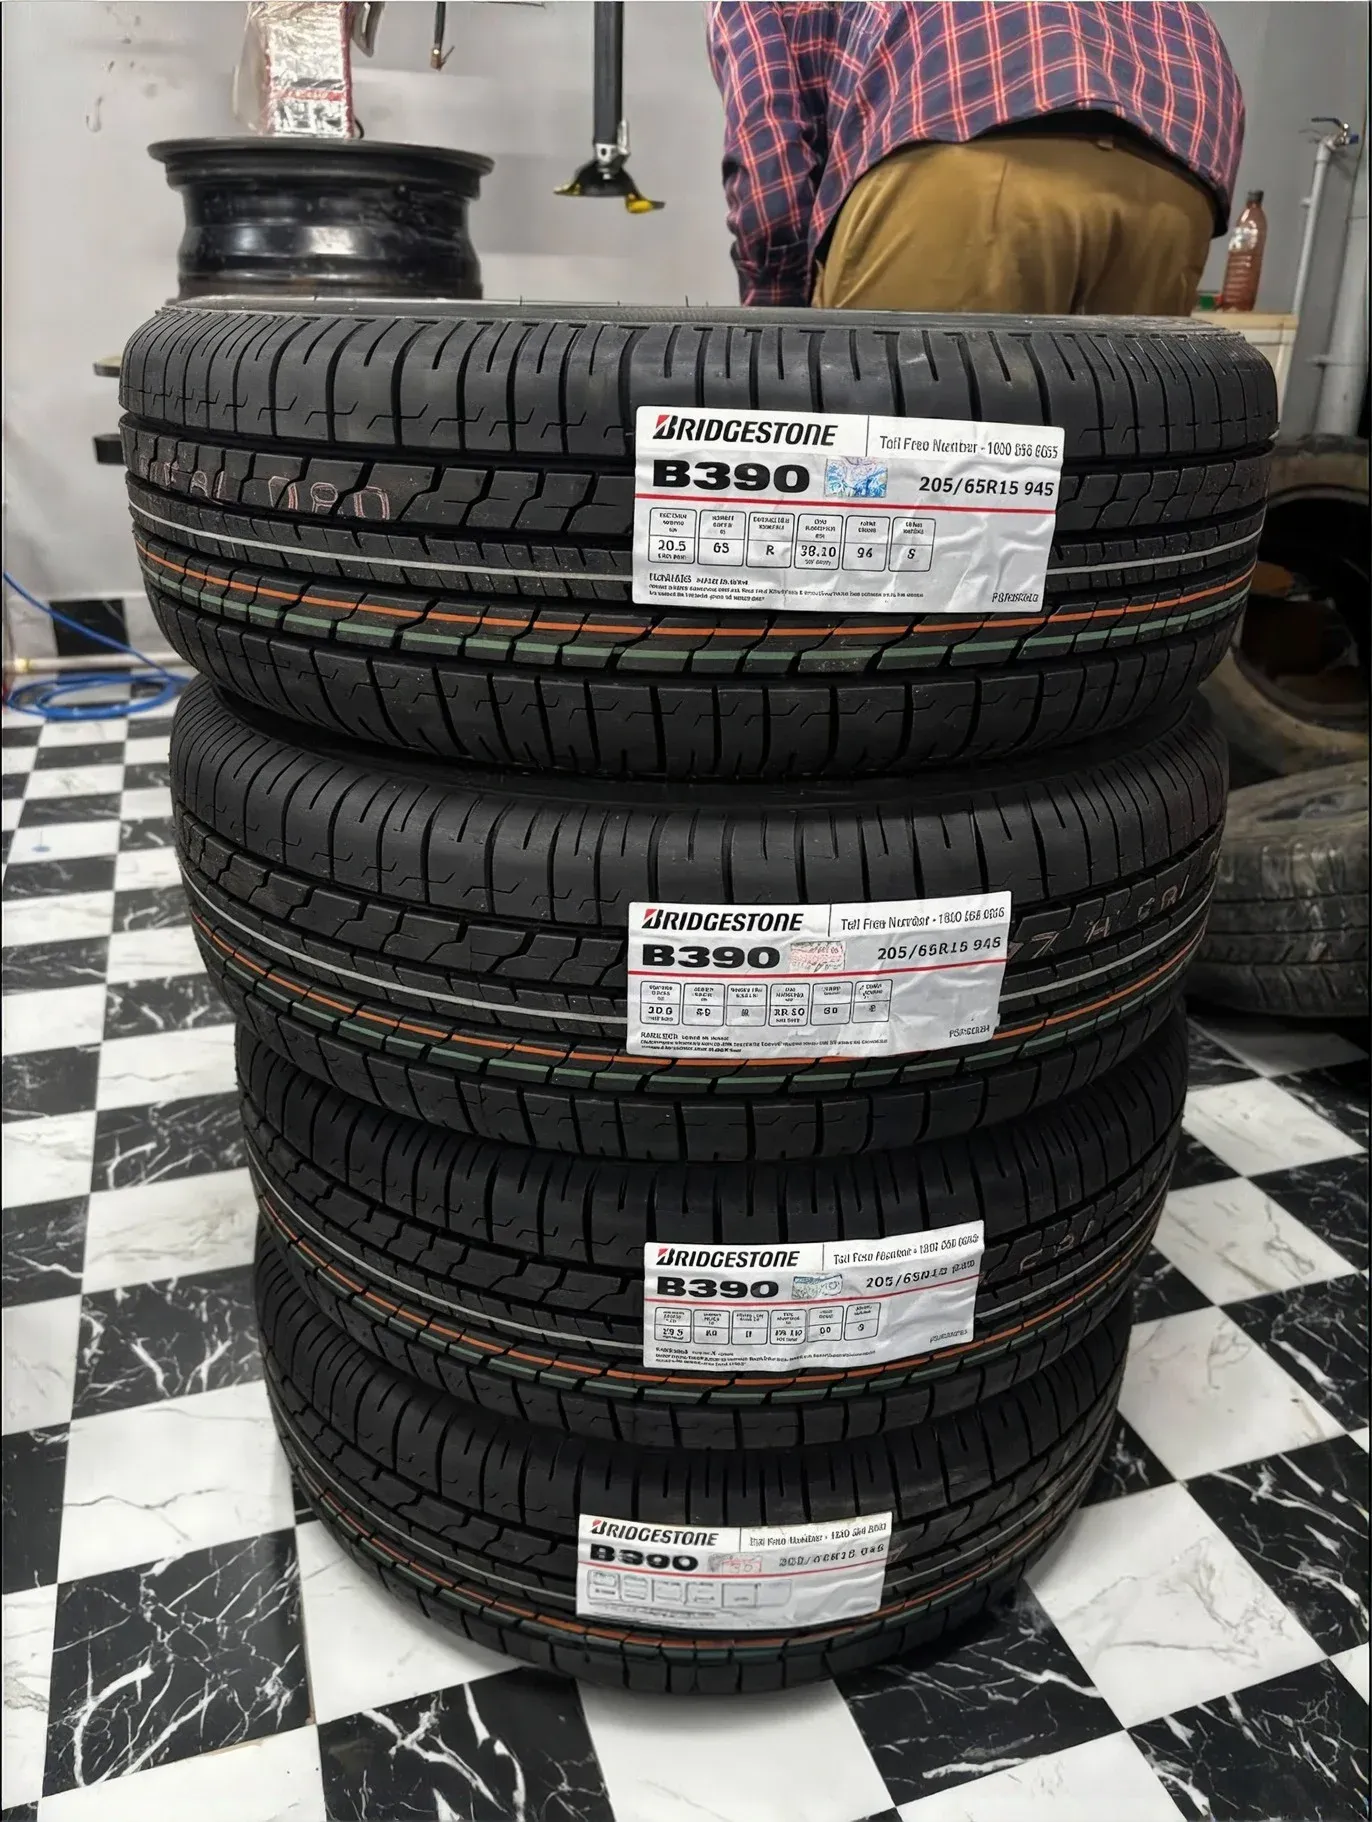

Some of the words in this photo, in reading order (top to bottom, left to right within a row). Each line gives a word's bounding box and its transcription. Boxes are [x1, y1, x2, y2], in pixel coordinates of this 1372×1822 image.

[653, 415, 838, 446] BRIDGESTONE
[653, 460, 810, 493] B390
[919, 476, 1019, 496] 205/65R15
[765, 544, 776, 556] R
[642, 908, 803, 932] BRIDGESTONE
[642, 944, 781, 969] B390
[656, 1247, 800, 1268] BRIDGESTONE
[657, 1275, 779, 1299] B390
[590, 1519, 719, 1547] BRIDGESTONE
[590, 1543, 699, 1572] B390
